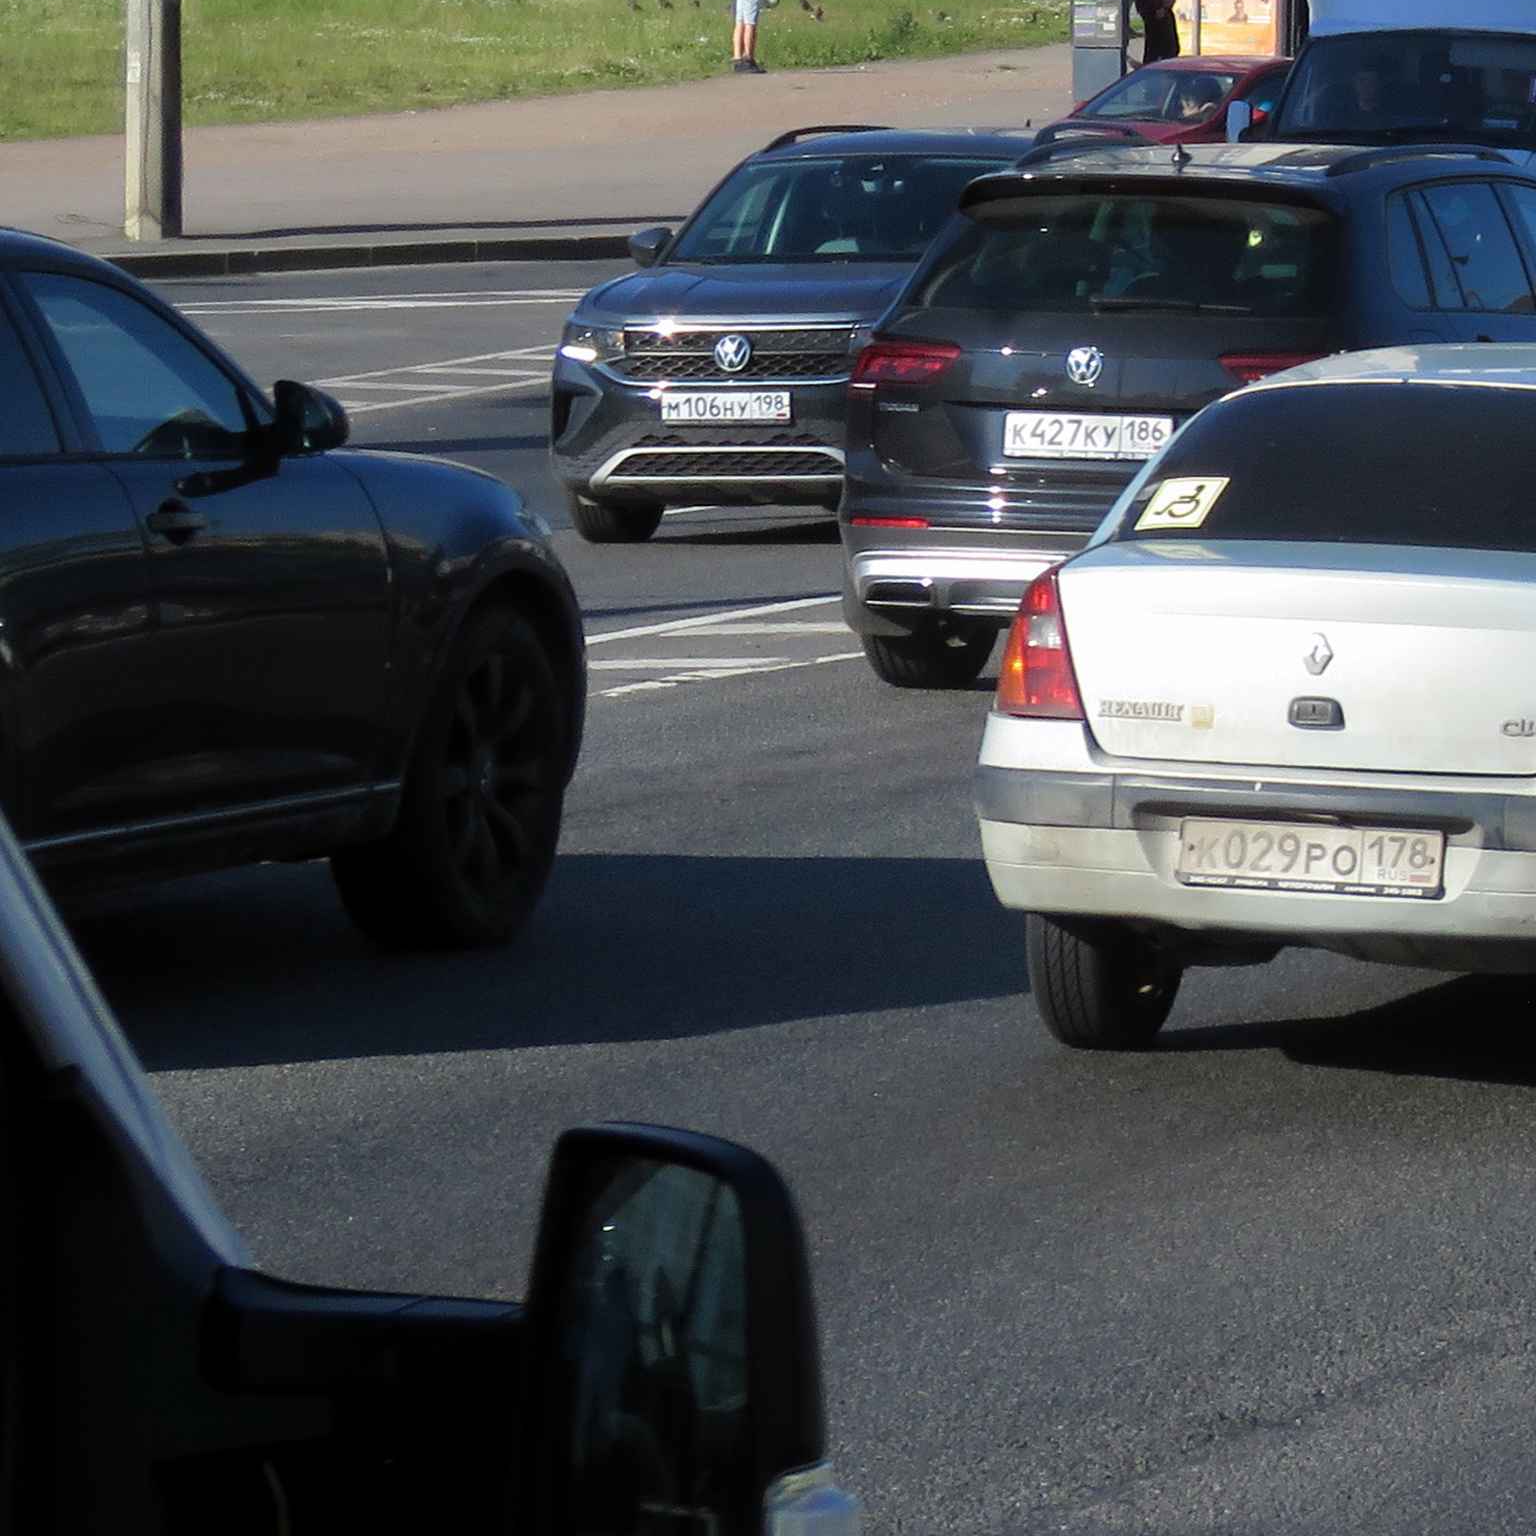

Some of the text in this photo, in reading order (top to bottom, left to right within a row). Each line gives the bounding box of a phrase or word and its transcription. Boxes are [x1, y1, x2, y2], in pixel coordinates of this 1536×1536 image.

[667, 394, 785, 417] М106НУ 198
[1012, 418, 1165, 448] К427КУ 186
[1198, 828, 1430, 877] К029РО 178
[1377, 868, 1408, 882] RUS
